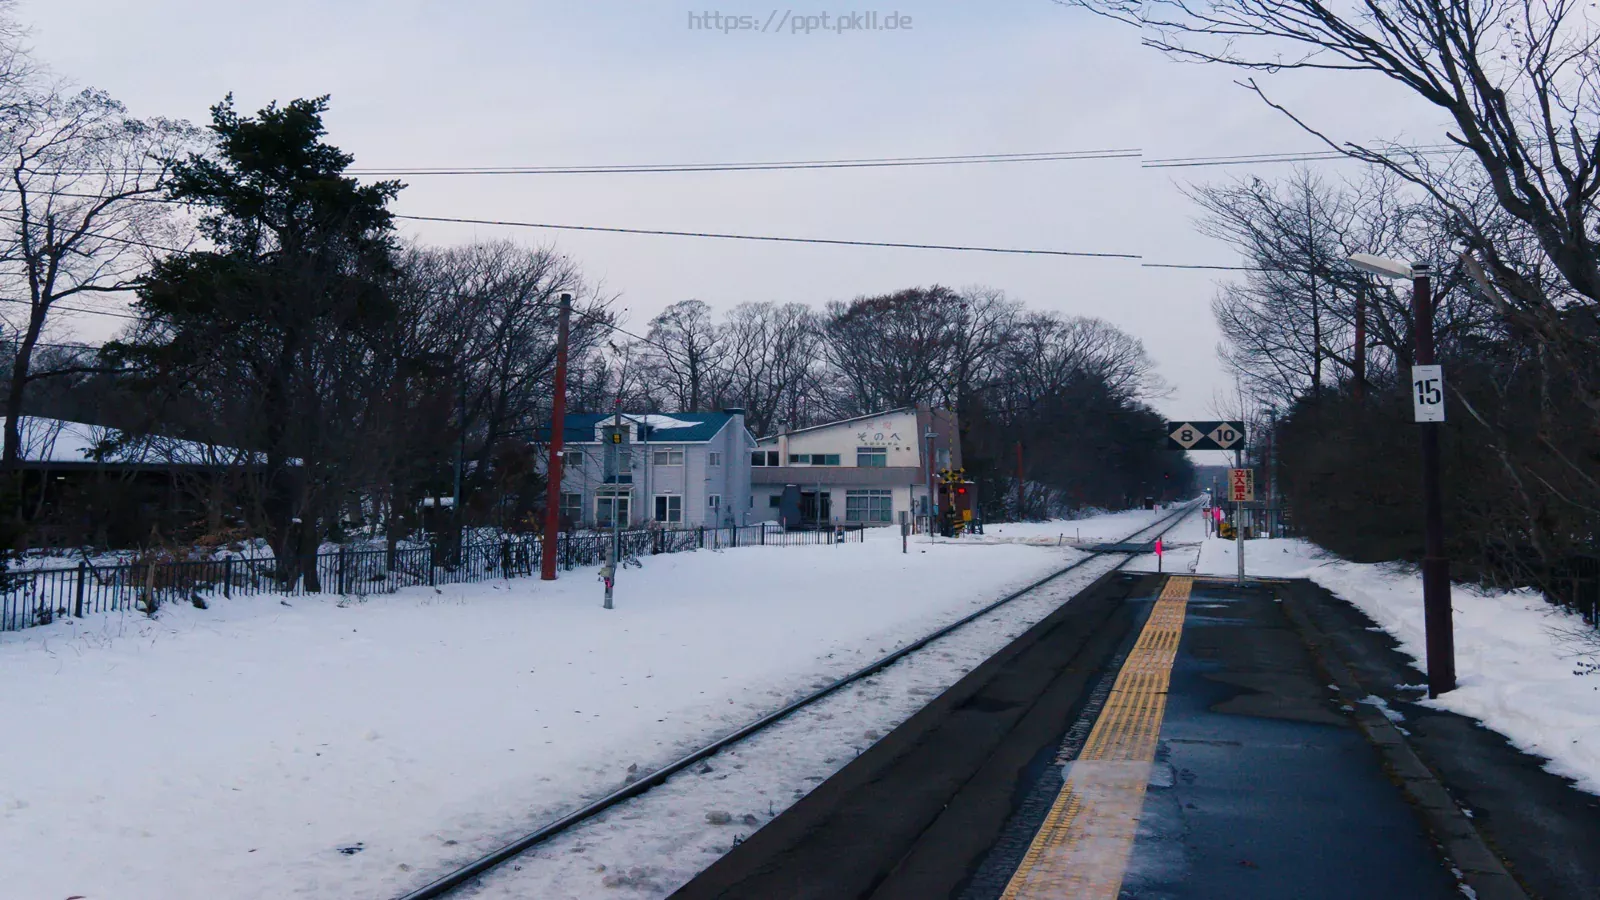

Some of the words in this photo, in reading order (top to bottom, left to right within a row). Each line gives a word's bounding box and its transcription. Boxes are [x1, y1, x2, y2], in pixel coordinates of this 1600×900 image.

[1414, 378, 1441, 405] 15
[1181, 429, 1193, 442] 8
[1216, 429, 1235, 442] 10
